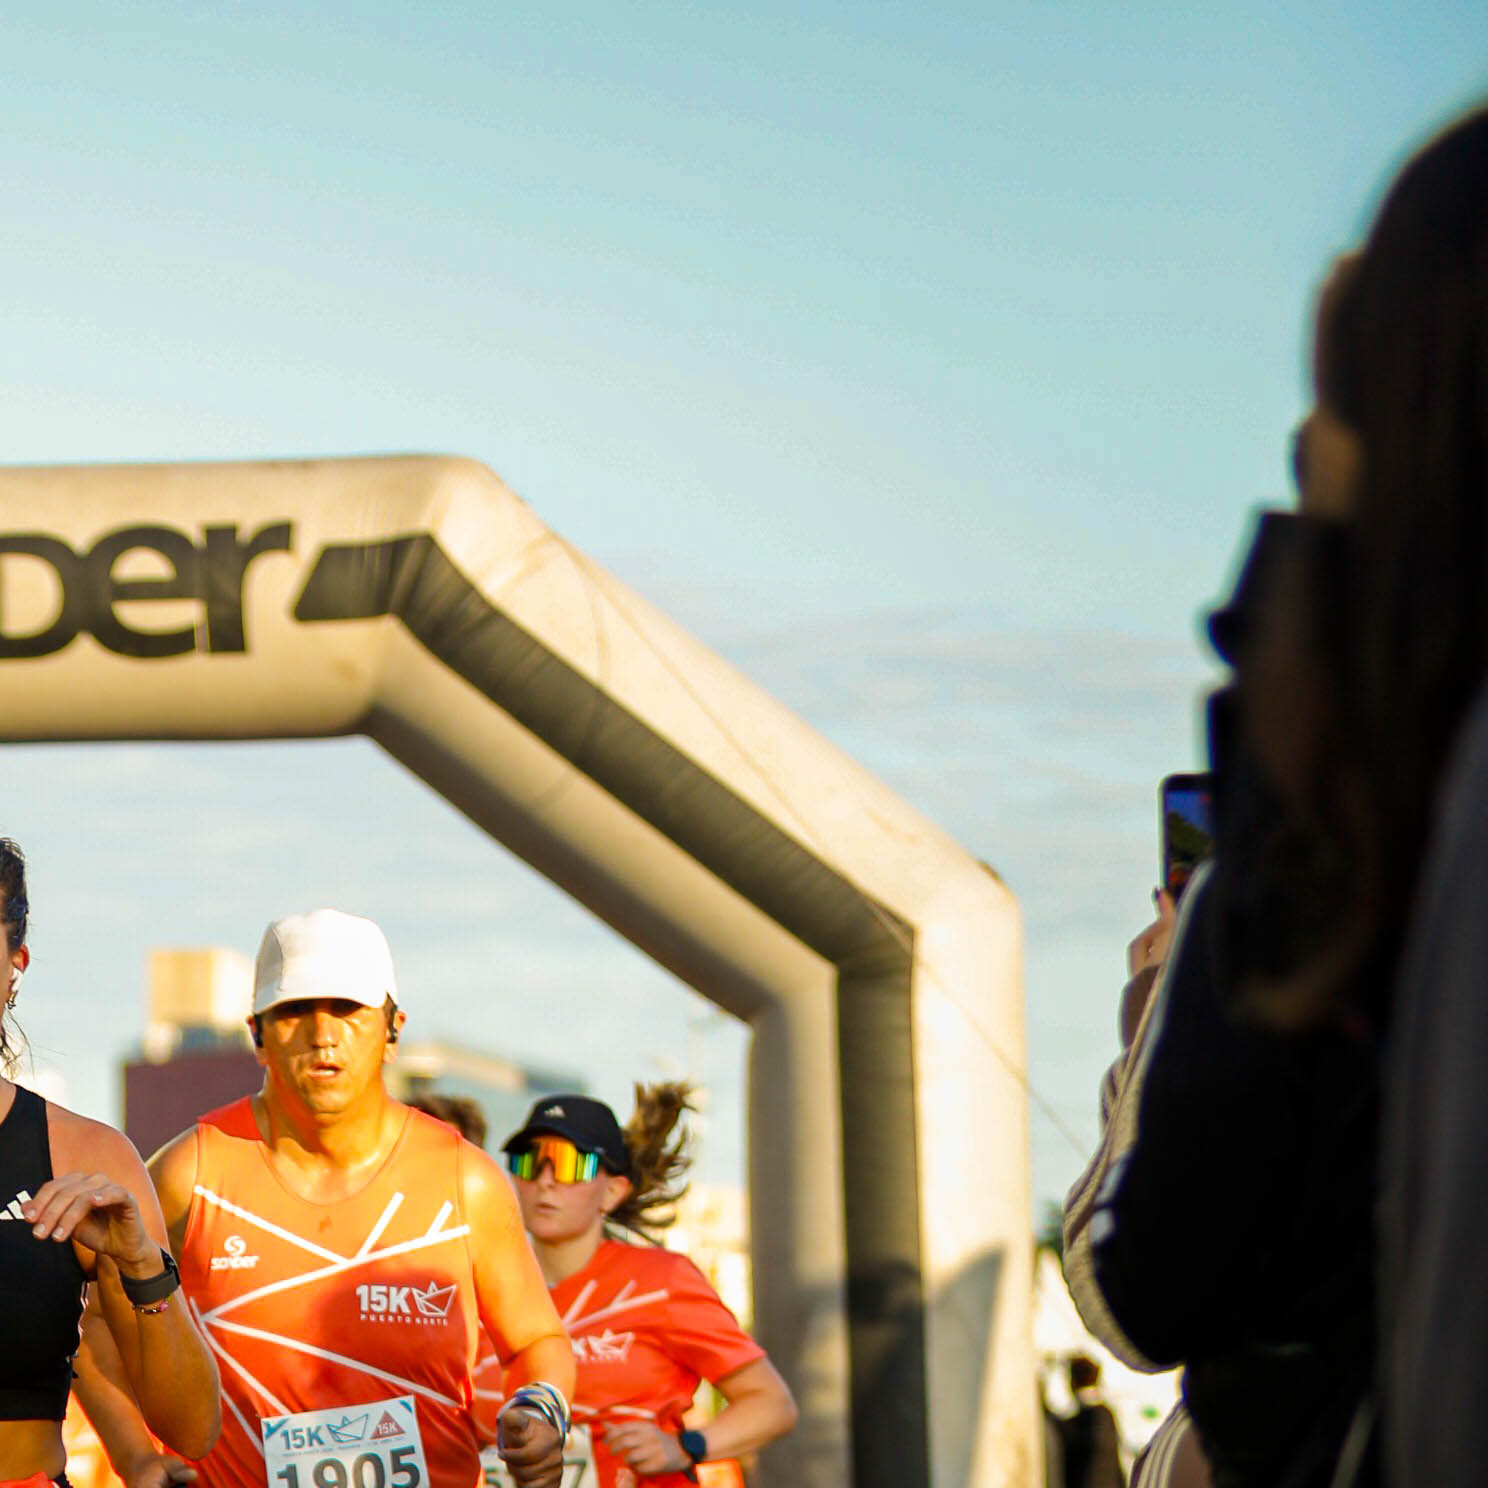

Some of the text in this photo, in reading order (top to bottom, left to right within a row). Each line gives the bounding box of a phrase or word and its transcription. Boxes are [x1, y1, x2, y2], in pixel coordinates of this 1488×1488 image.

[355, 1284, 411, 1314] 15K
[360, 1313, 411, 1324] PUERTO
[280, 1421, 399, 1450] 15K 15K
